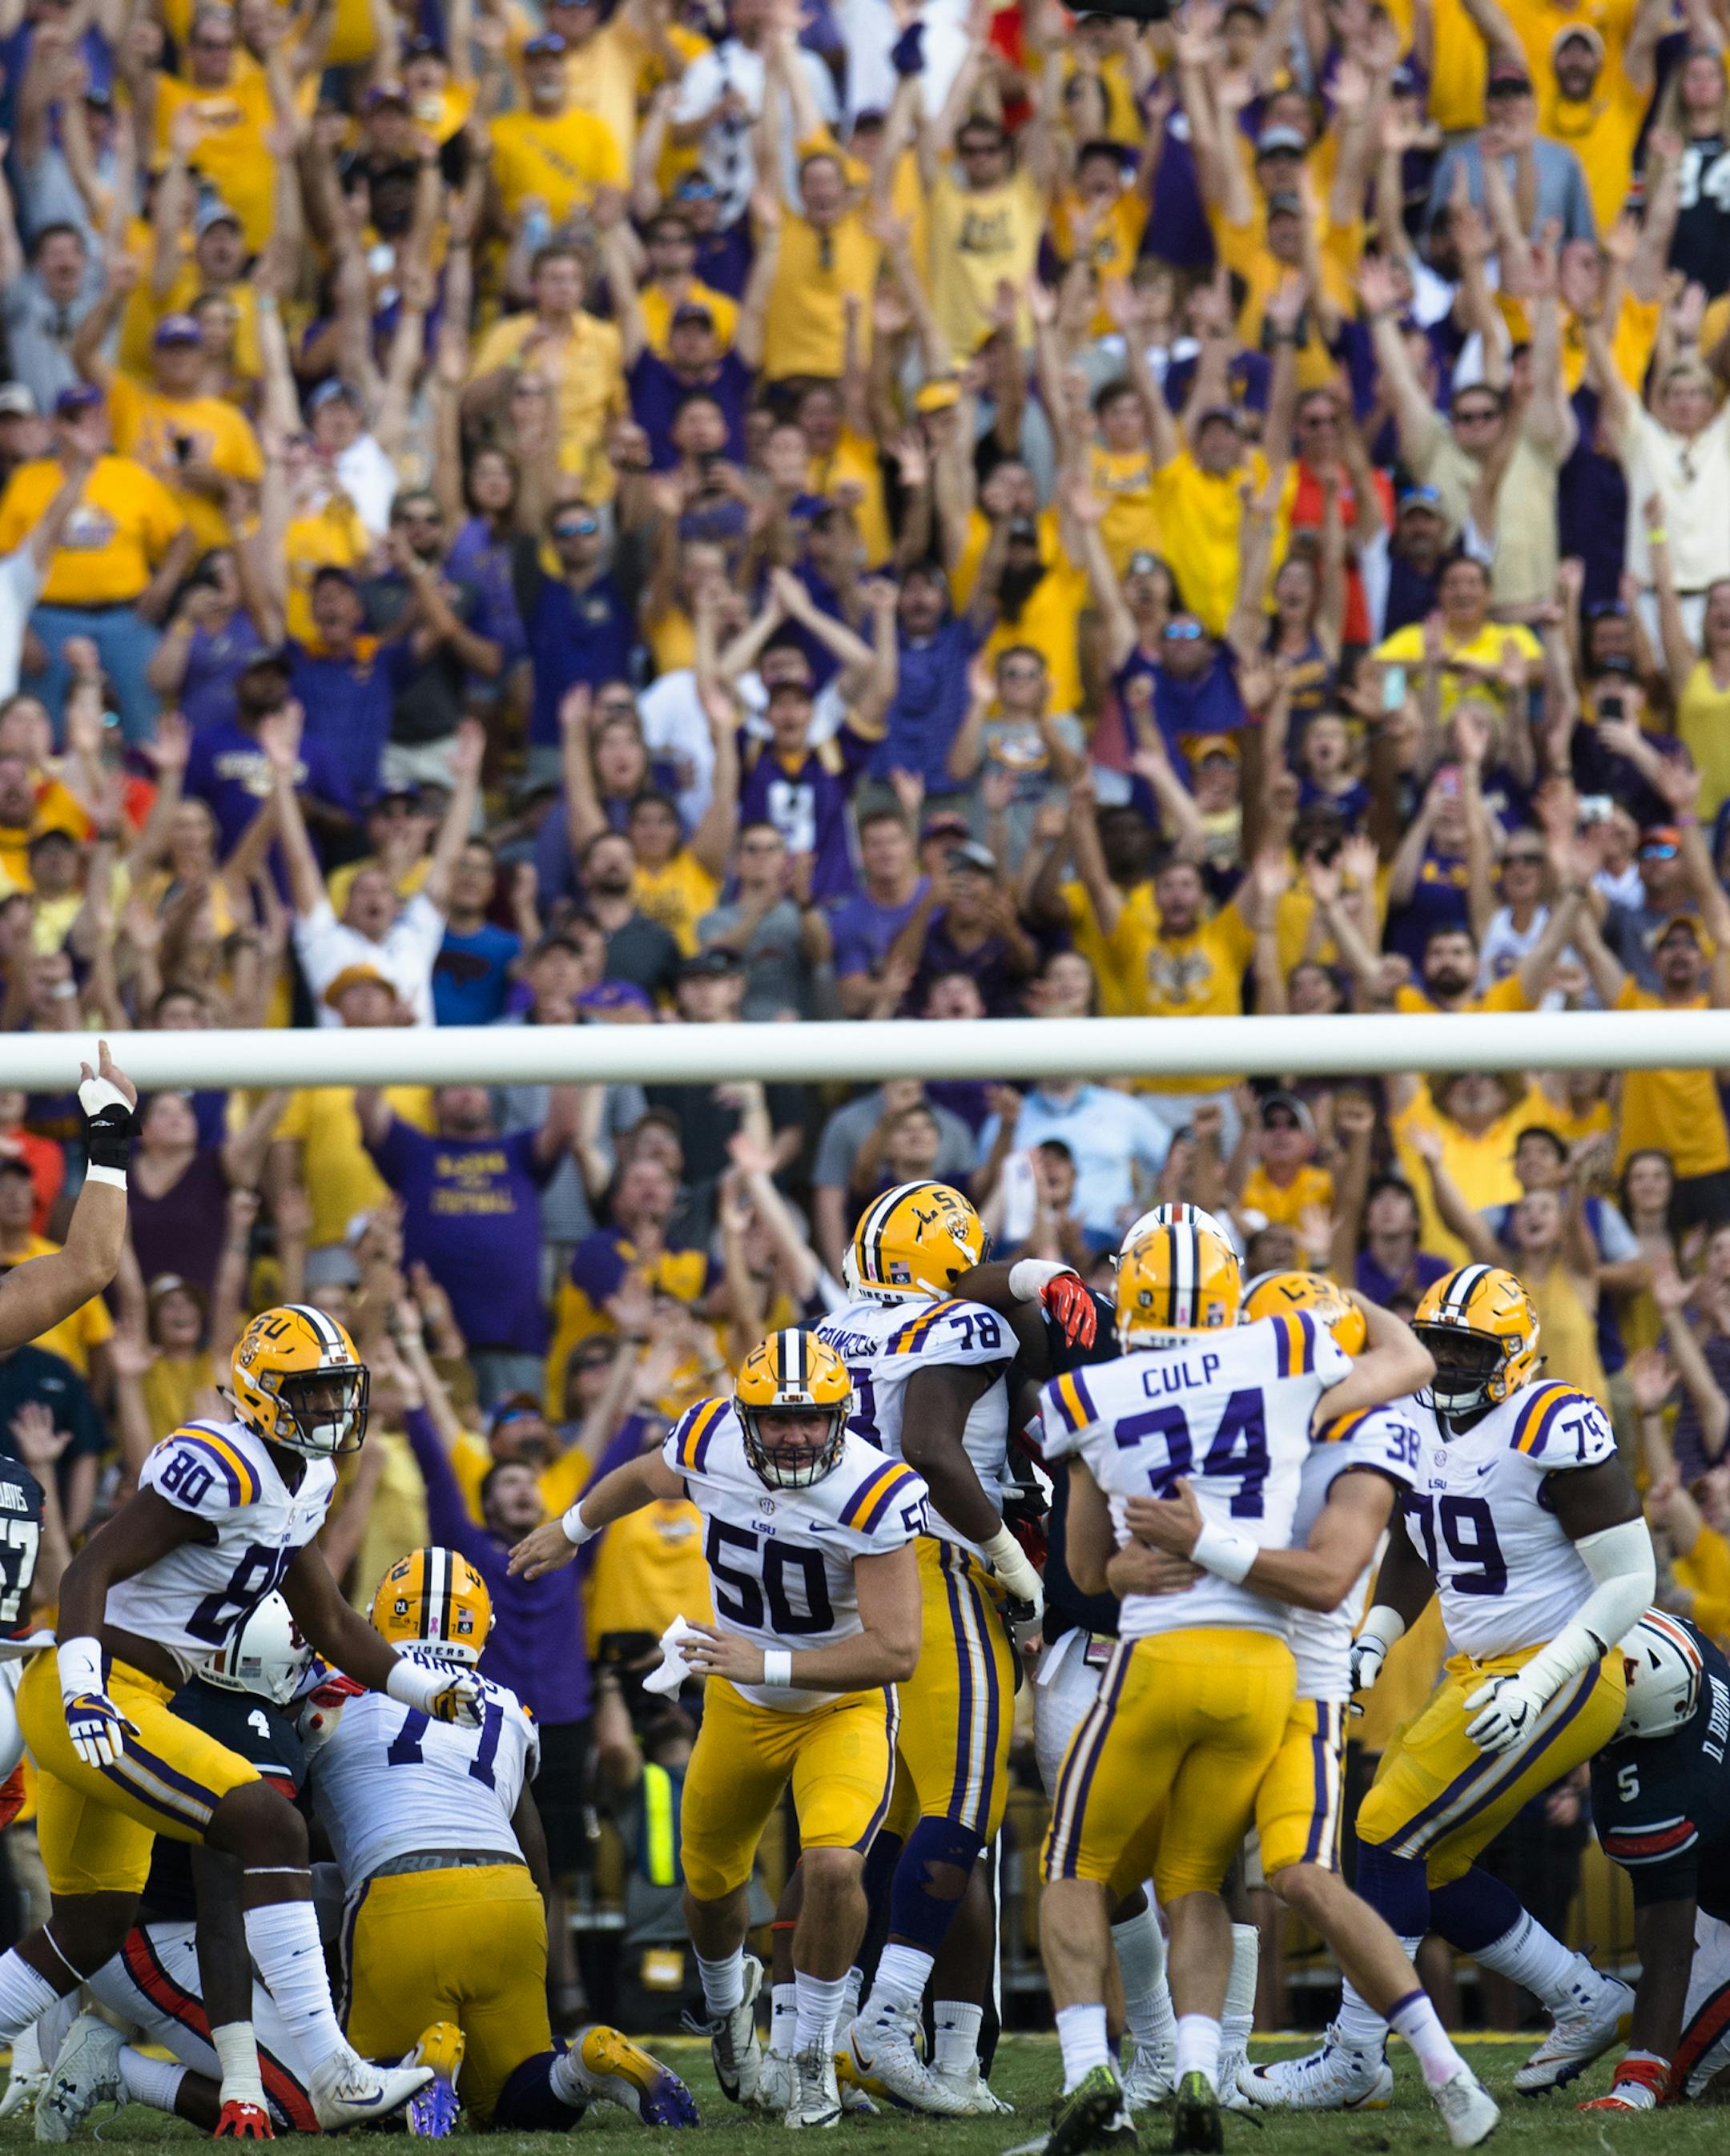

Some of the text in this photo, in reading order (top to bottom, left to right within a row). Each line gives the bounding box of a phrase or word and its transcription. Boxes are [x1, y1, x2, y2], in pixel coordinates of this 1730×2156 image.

[949, 1312, 1000, 1350] 78
[781, 1394, 803, 1402] LSU
[1142, 1354, 1221, 1398] CULP
[1114, 1386, 1270, 1518] 34
[1386, 1423, 1422, 1471] 38
[1561, 1411, 1604, 1462] 79
[160, 1450, 215, 1508] 80
[1428, 1478, 1447, 1490] LSU
[752, 1520, 776, 1536] LSU
[1400, 1494, 1508, 1595] 79
[0, 1517, 39, 1622] 7
[706, 1512, 835, 1634] 50
[407, 1645, 465, 1658] TIGERS
[247, 1708, 271, 1740] 4
[1707, 1673, 1730, 1744] BROWN
[1617, 1763, 1640, 1803] 5
